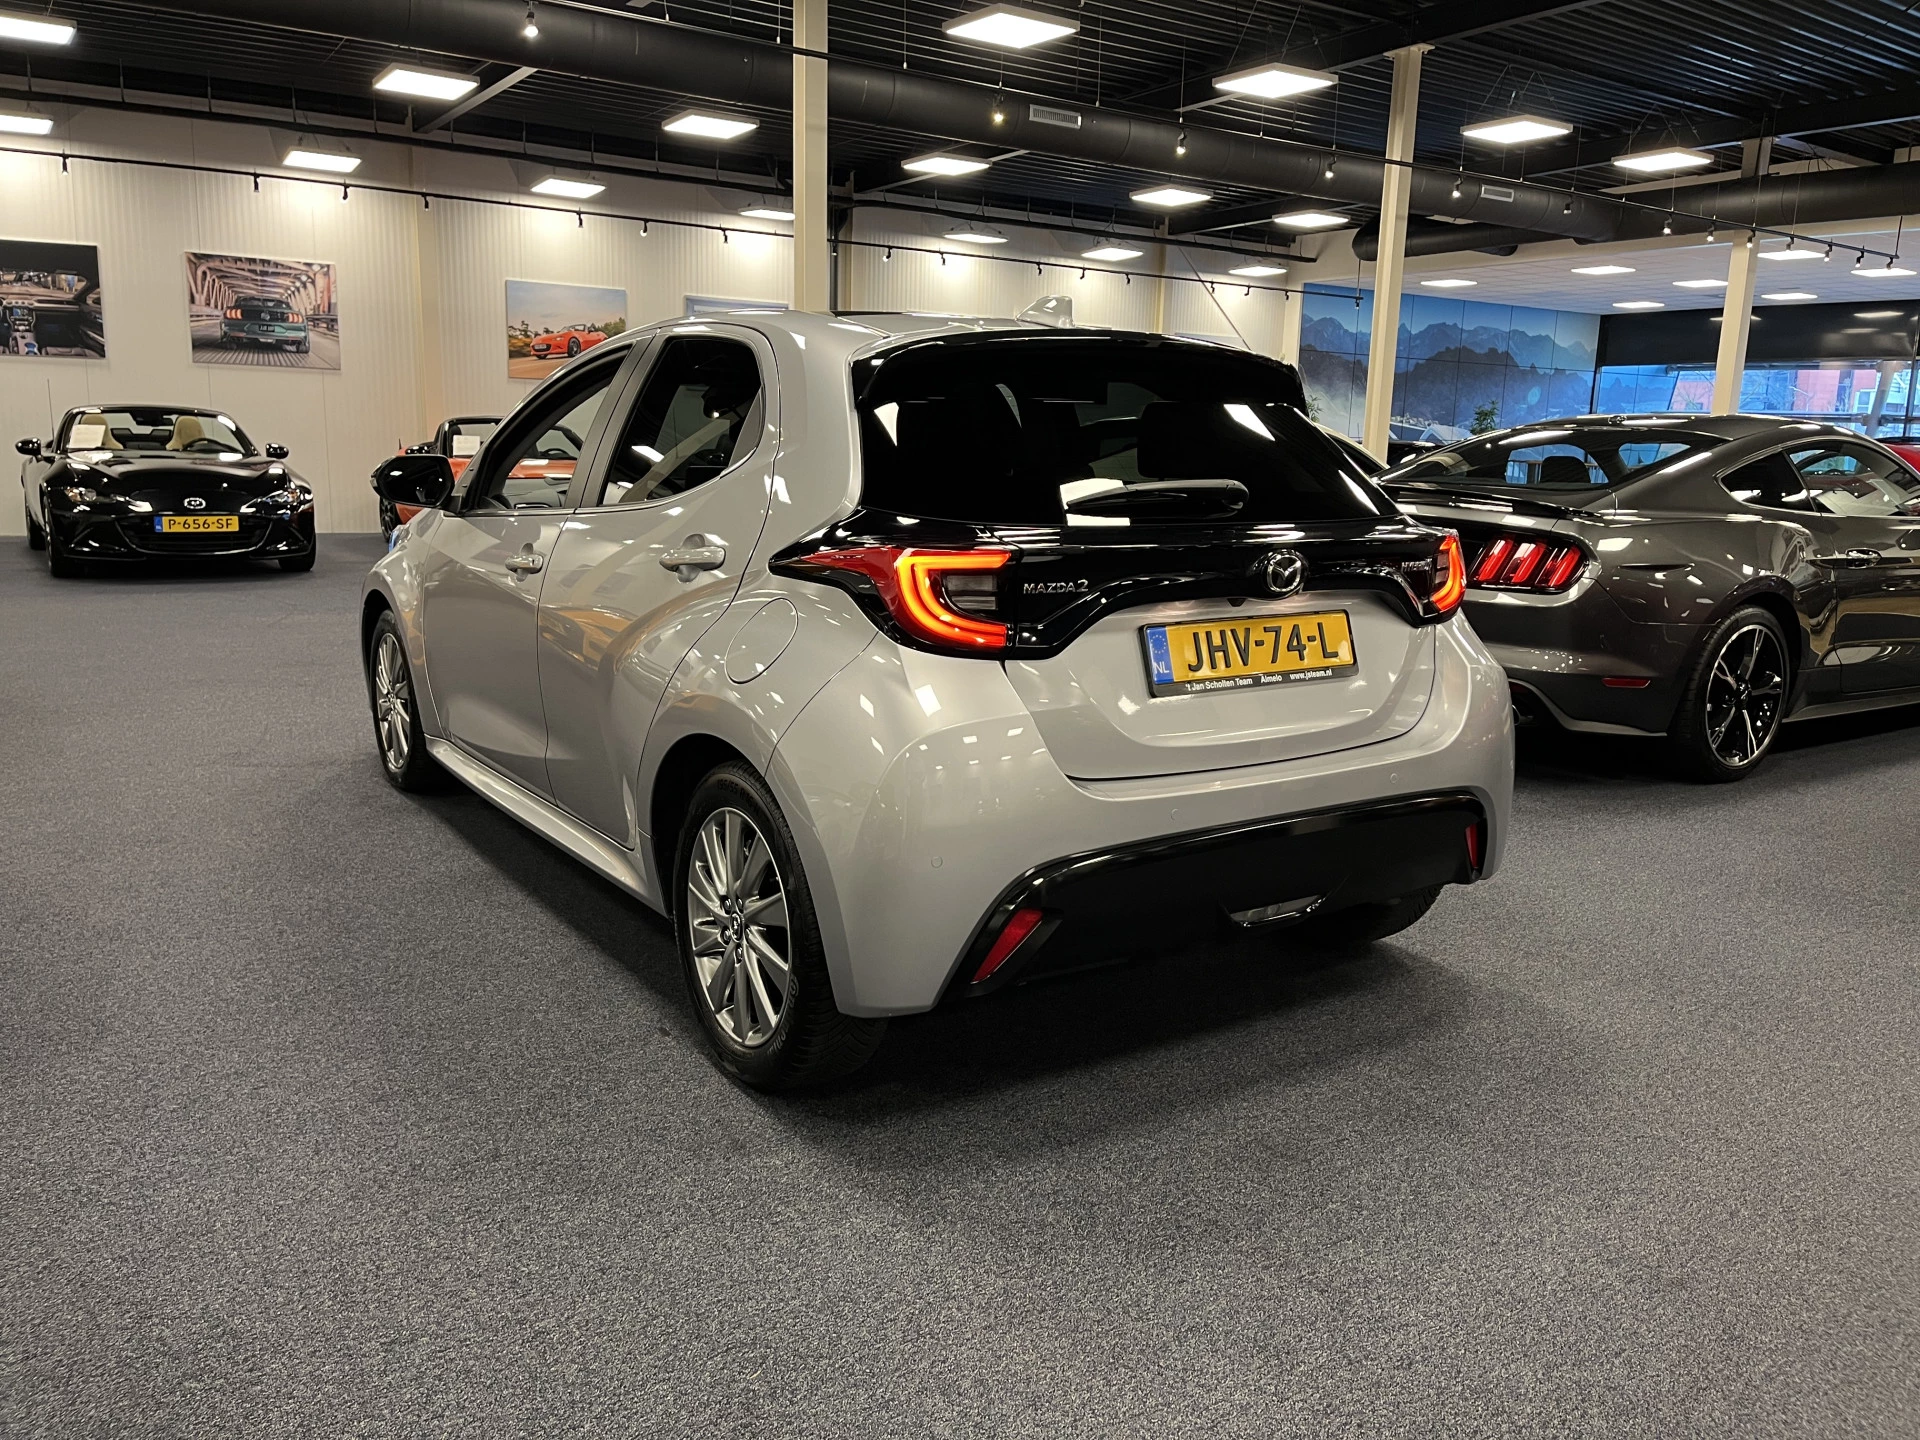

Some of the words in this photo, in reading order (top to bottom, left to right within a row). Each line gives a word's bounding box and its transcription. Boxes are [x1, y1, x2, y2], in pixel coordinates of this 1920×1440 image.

[168, 518, 233, 530] P-656-SF
[1187, 622, 1339, 672] JHV-74-L
[1154, 662, 1170, 674] NL
[1192, 682, 1205, 690] Jan
[1235, 677, 1253, 686] Team
[1260, 674, 1283, 684] Almelo
